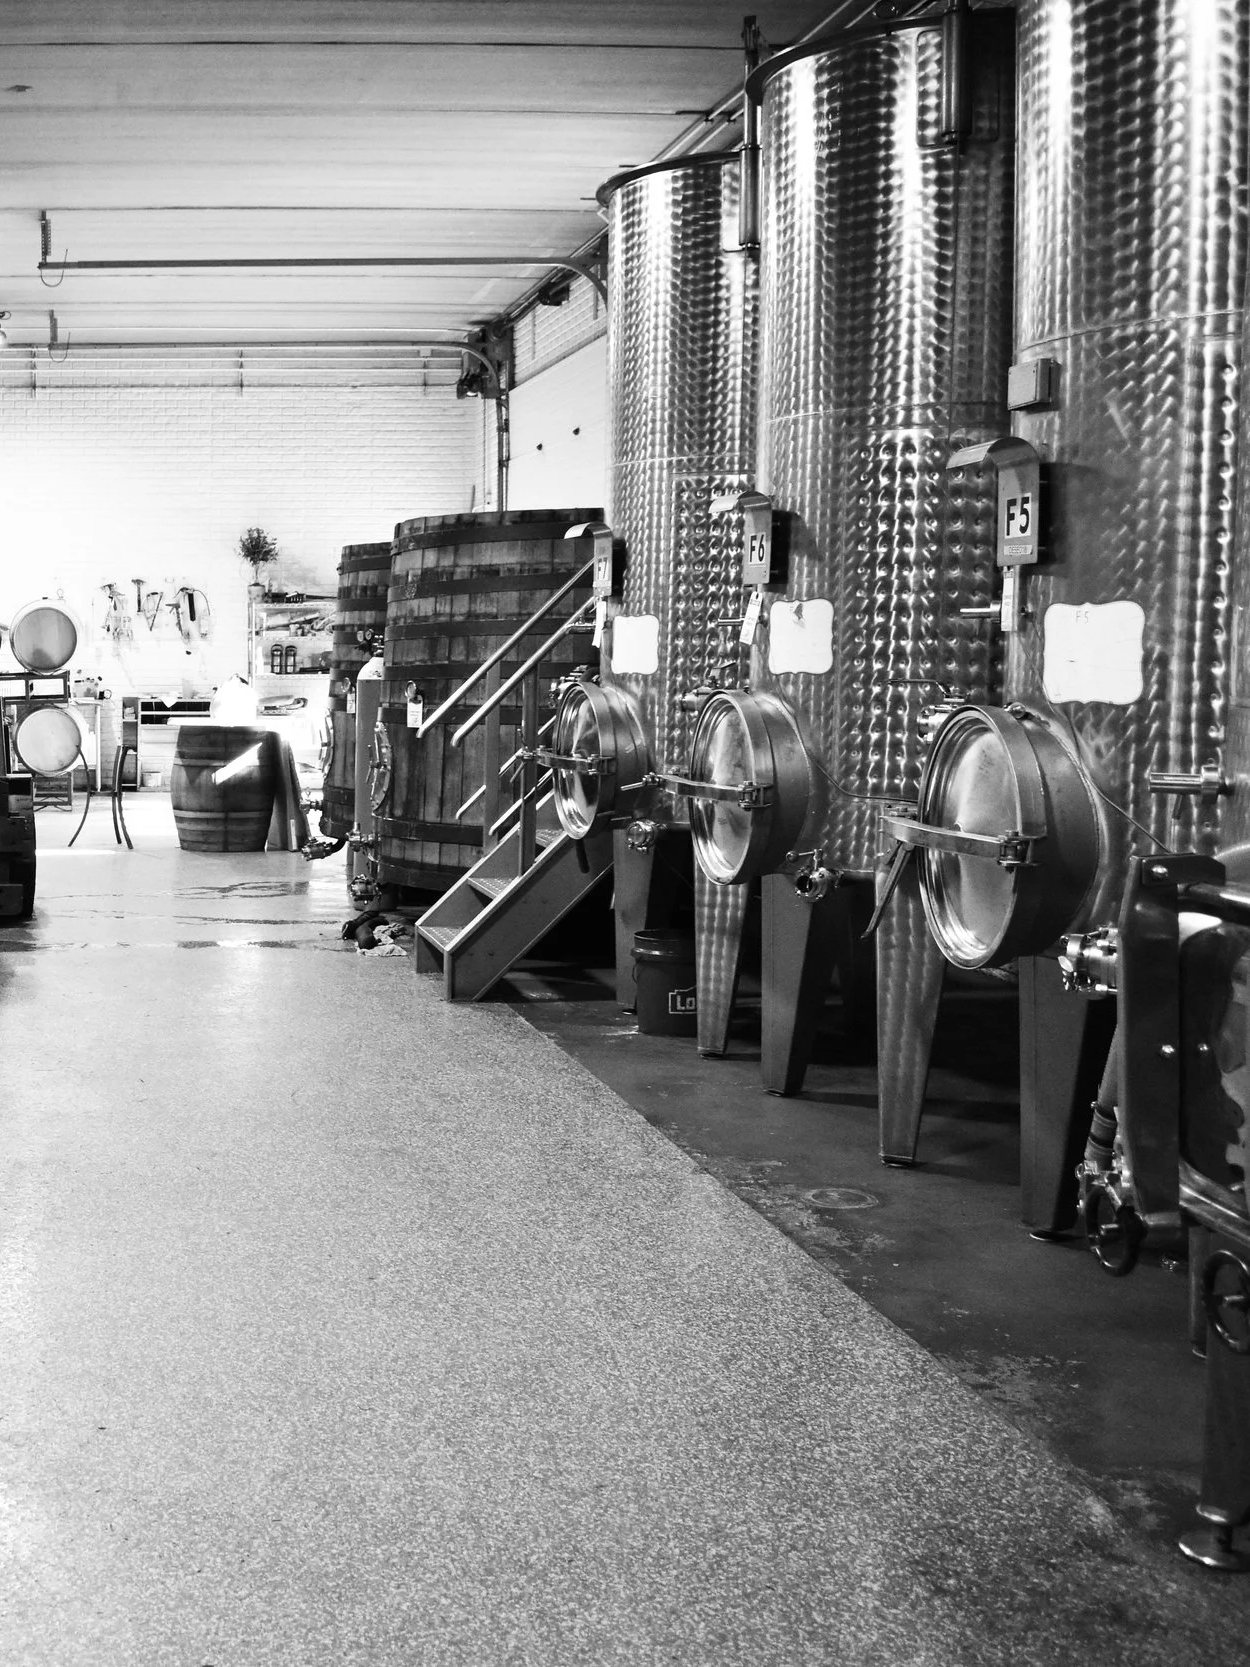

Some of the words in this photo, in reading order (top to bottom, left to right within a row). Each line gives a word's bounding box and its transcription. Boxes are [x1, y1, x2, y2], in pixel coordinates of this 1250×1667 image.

[1006, 496, 1030, 536] F5
[749, 534, 765, 563] F6
[597, 557, 608, 580] F7
[1076, 610, 1090, 624] F5
